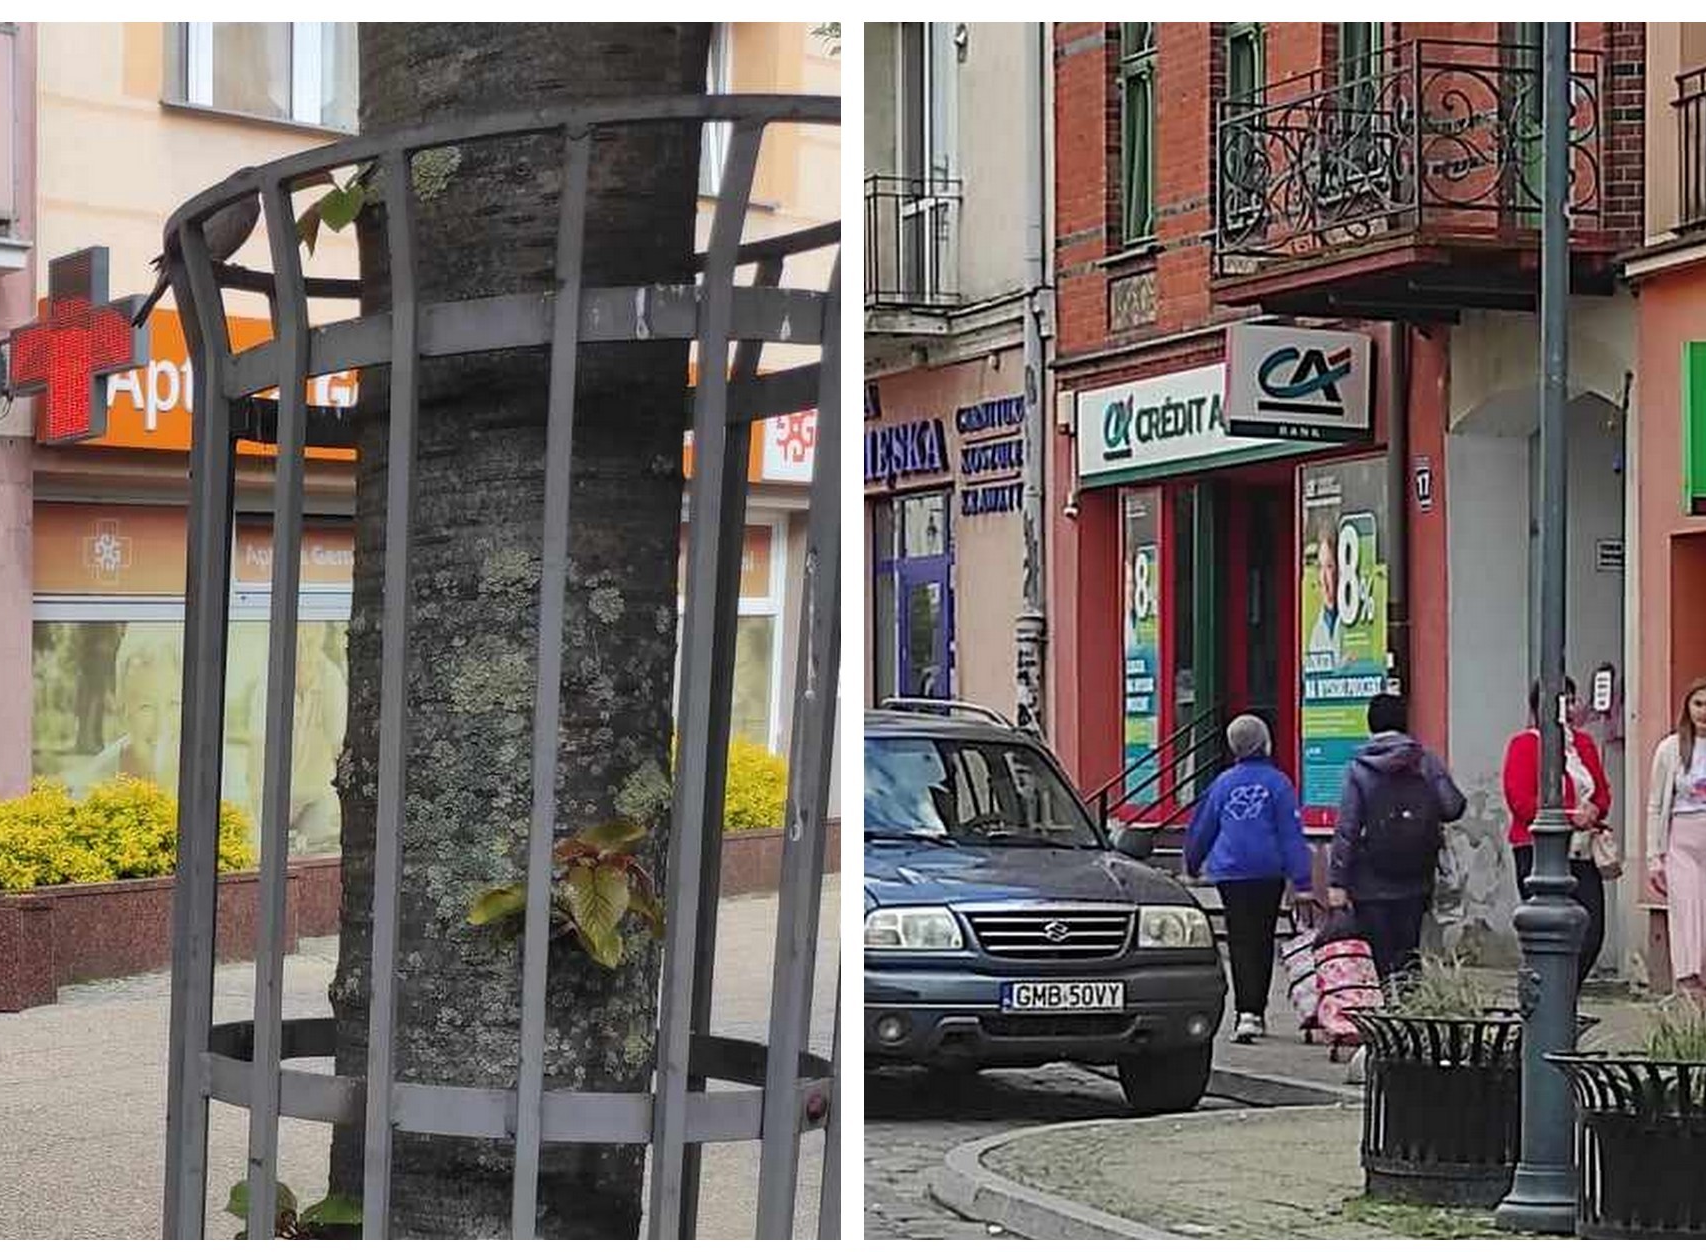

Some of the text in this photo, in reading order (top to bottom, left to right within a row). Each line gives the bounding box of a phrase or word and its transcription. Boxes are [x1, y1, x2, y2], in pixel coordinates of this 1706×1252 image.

[1135, 396, 1207, 444] CRÉDIT
[1278, 424, 1322, 439] BANK
[1016, 985, 1119, 1006] GMB 50VY
